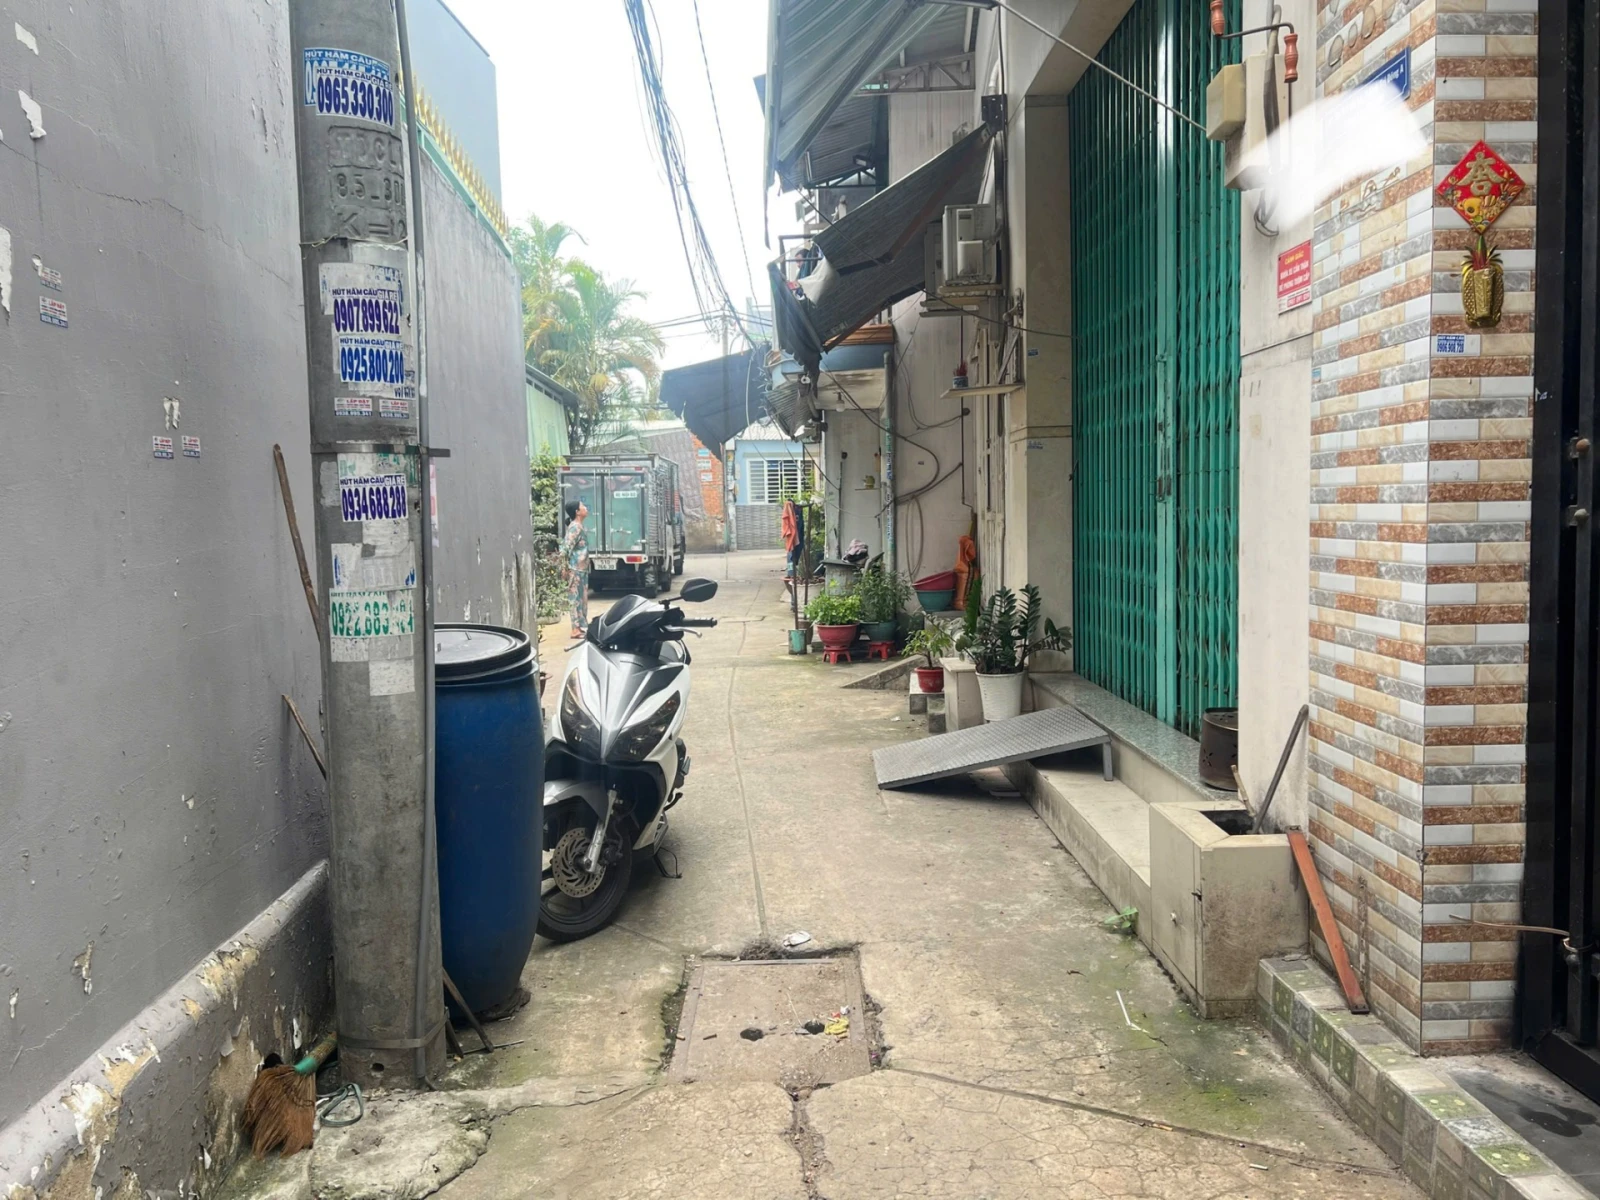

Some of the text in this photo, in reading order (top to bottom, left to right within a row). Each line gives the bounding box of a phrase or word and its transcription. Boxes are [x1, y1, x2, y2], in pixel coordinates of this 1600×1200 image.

[317, 77, 394, 126] 0965.330.300
[333, 298, 400, 334] 0907.899.622
[340, 347, 404, 384] 0925.800.200
[341, 485, 406, 521] 0934.688.288
